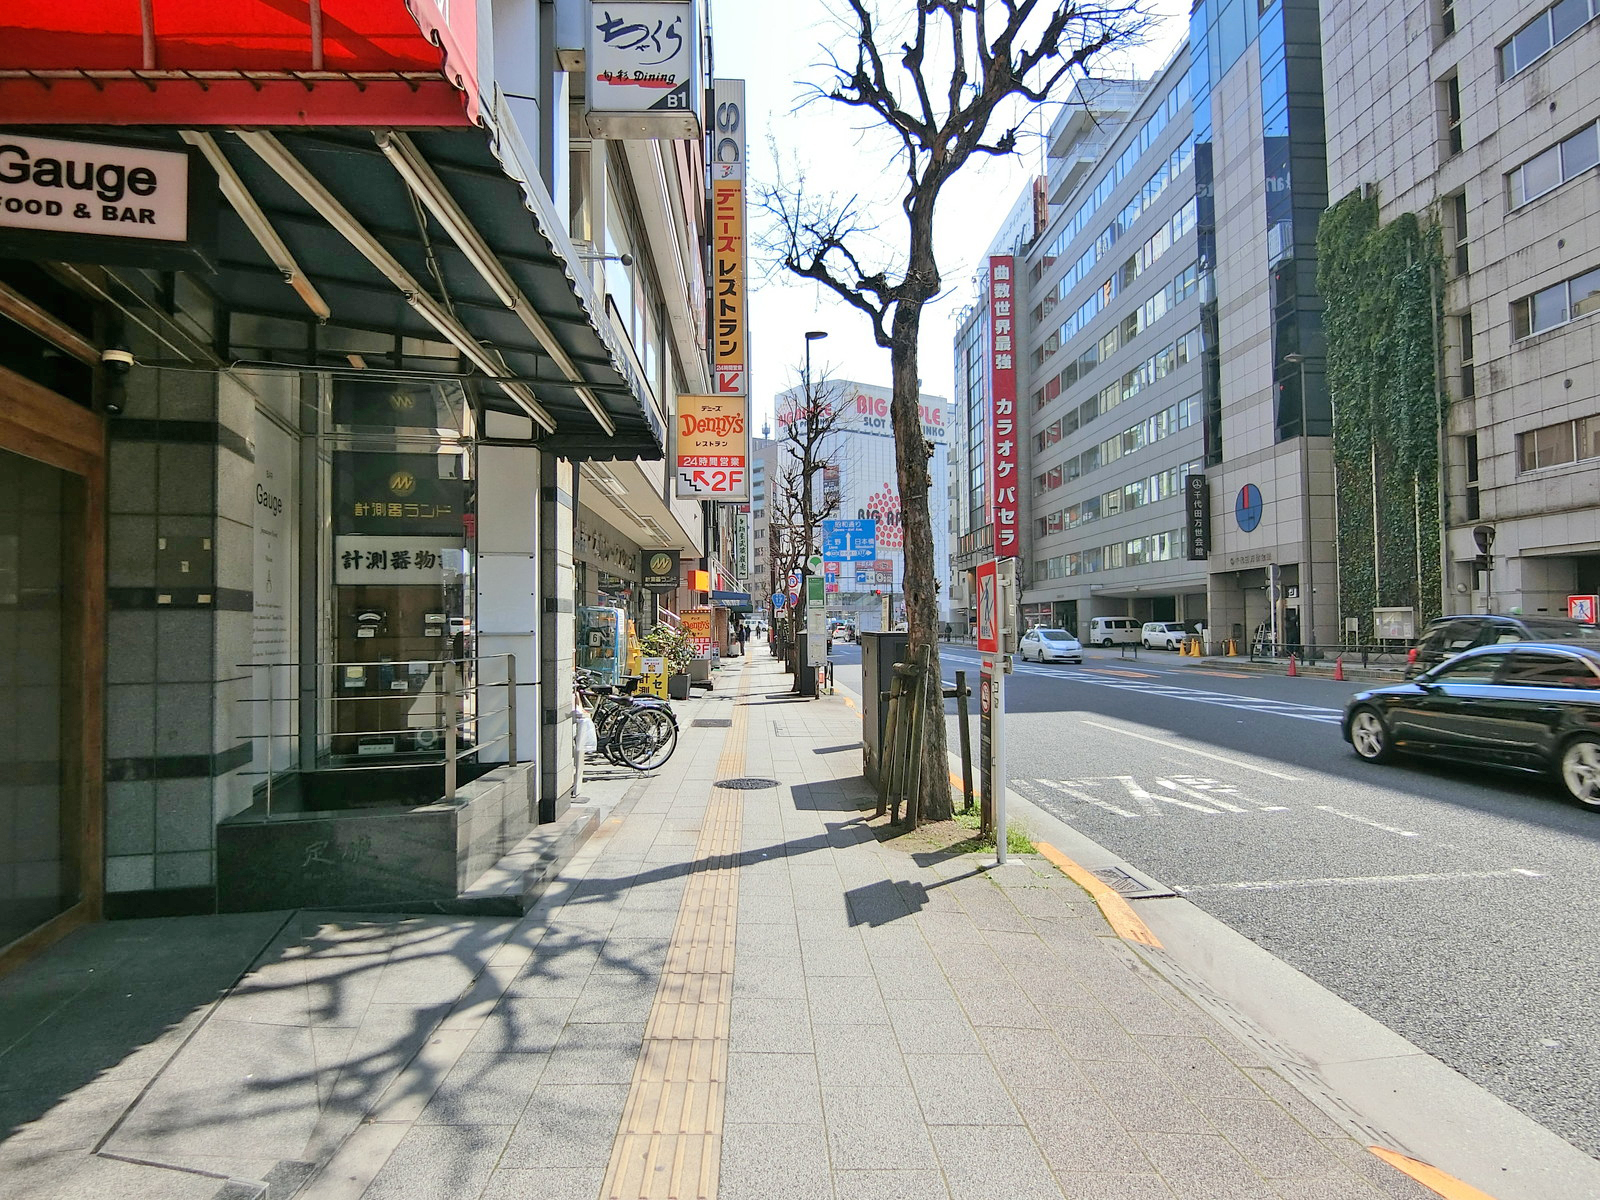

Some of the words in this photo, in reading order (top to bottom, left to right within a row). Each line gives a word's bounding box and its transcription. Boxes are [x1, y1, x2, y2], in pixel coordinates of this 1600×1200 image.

[634, 70, 676, 84] Dining
[667, 91, 687, 108] B1
[0, 144, 158, 202] Gauge
[0, 197, 63, 217] OOD
[73, 203, 91, 219] &
[102, 205, 156, 225] BAR
[717, 188, 741, 253] デニーズ
[719, 259, 738, 357] レストラン
[994, 264, 1012, 370] 曲数世界最強
[857, 395, 888, 417] BIG
[680, 413, 744, 437] Denny's
[864, 417, 886, 428] SLOT
[996, 398, 1015, 478] カラオケ
[683, 457, 740, 467] 24時間営業
[712, 471, 743, 491] 2F
[256, 483, 283, 517] Gauge
[355, 503, 452, 518] 計測器ランド
[998, 487, 1016, 546] パセラ
[1193, 491, 1204, 556] 千代田万世会館
[341, 551, 445, 571] 計測器物
[592, 633, 598, 642] 6
